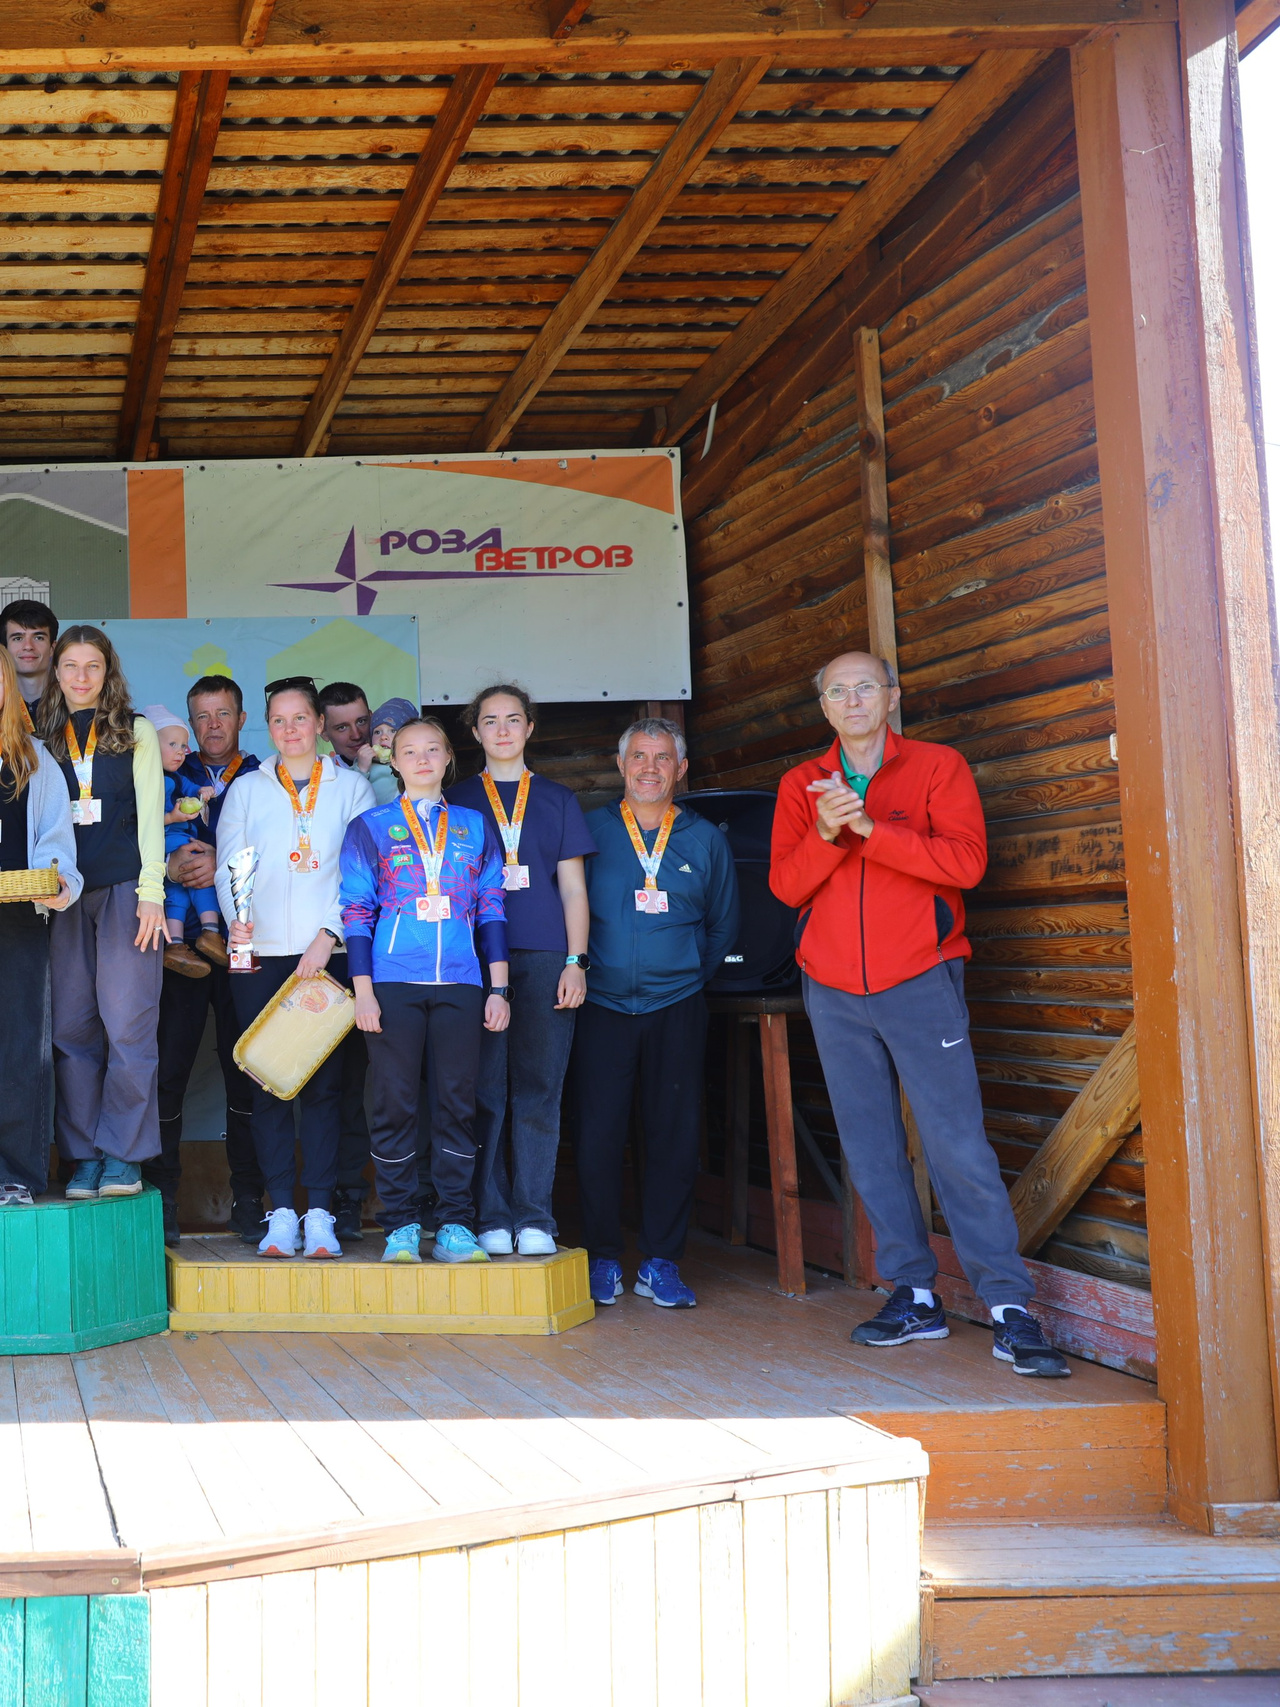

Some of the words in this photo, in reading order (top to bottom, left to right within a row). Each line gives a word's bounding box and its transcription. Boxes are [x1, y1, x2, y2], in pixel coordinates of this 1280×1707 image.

[380, 528, 502, 555] РОЗА
[475, 545, 634, 571] ВЕТРОВ
[312, 860, 319, 869] 3
[441, 908, 450, 917] 3
